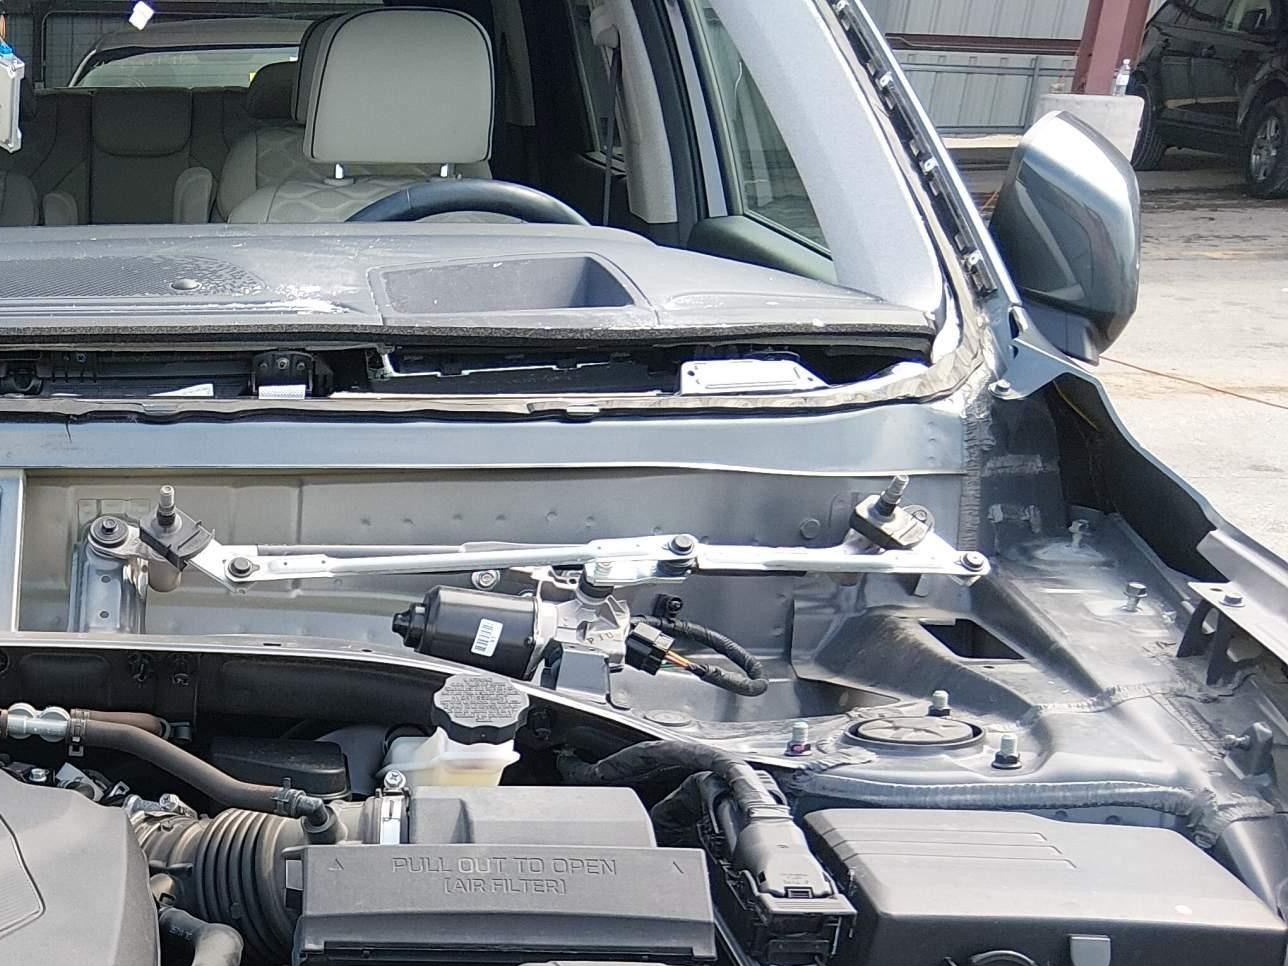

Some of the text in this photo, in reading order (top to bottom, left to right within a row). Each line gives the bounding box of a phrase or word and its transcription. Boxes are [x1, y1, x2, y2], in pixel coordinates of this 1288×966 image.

[391, 857, 617, 876] PULL OUT TO OPEN
